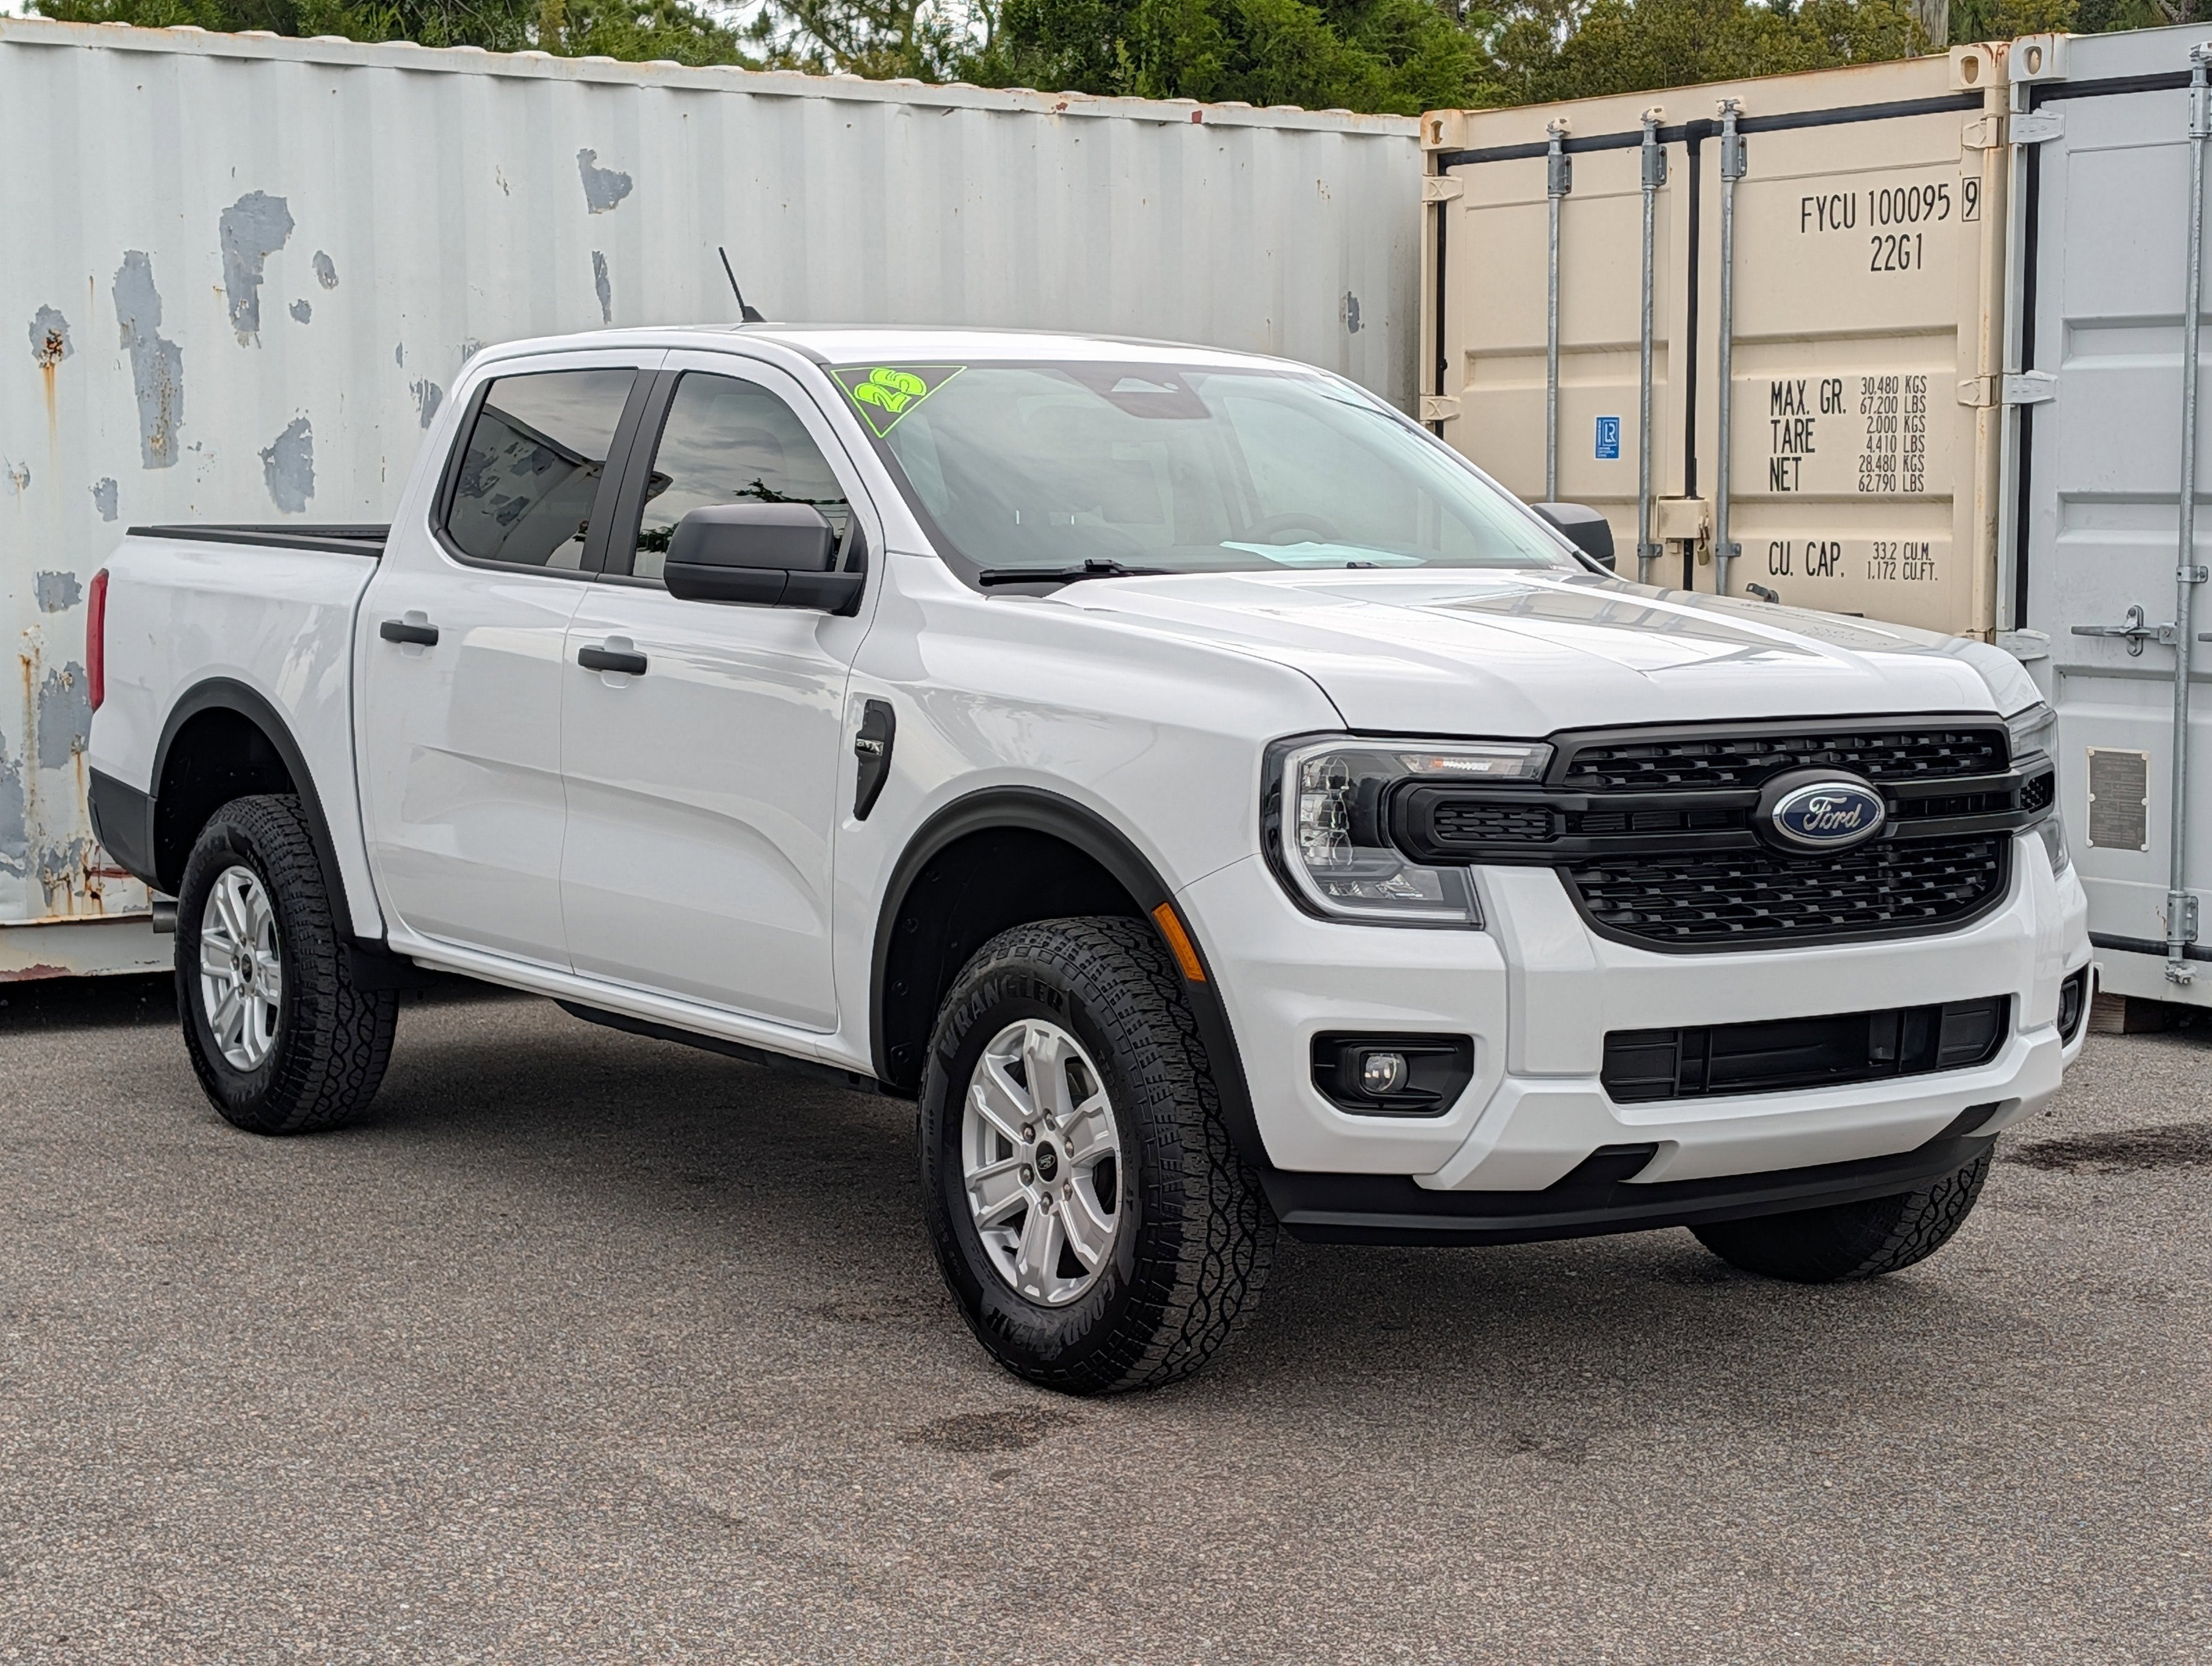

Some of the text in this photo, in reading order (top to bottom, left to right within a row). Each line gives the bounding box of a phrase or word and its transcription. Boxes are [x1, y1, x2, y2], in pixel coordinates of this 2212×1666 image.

[1801, 181, 1978, 233] FYCU 100095 9
[1870, 233, 1922, 272] 22G1
[854, 368, 927, 413] 25
[1770, 379, 1847, 416] MAX. GR.
[1905, 375, 1927, 394] KGS
[1904, 395, 1926, 413] LBS
[1770, 418, 1816, 454] TARE
[1904, 415, 1926, 433] KGS
[1903, 434, 1925, 453] LBS
[1770, 456, 1802, 492] NET
[1902, 454, 1925, 472] KGS
[1902, 473, 1924, 492] LBS
[1769, 541, 1844, 577] CU. CAP.
[1803, 796, 1862, 831] Ford
[940, 974, 1063, 1059] WRANGLER
